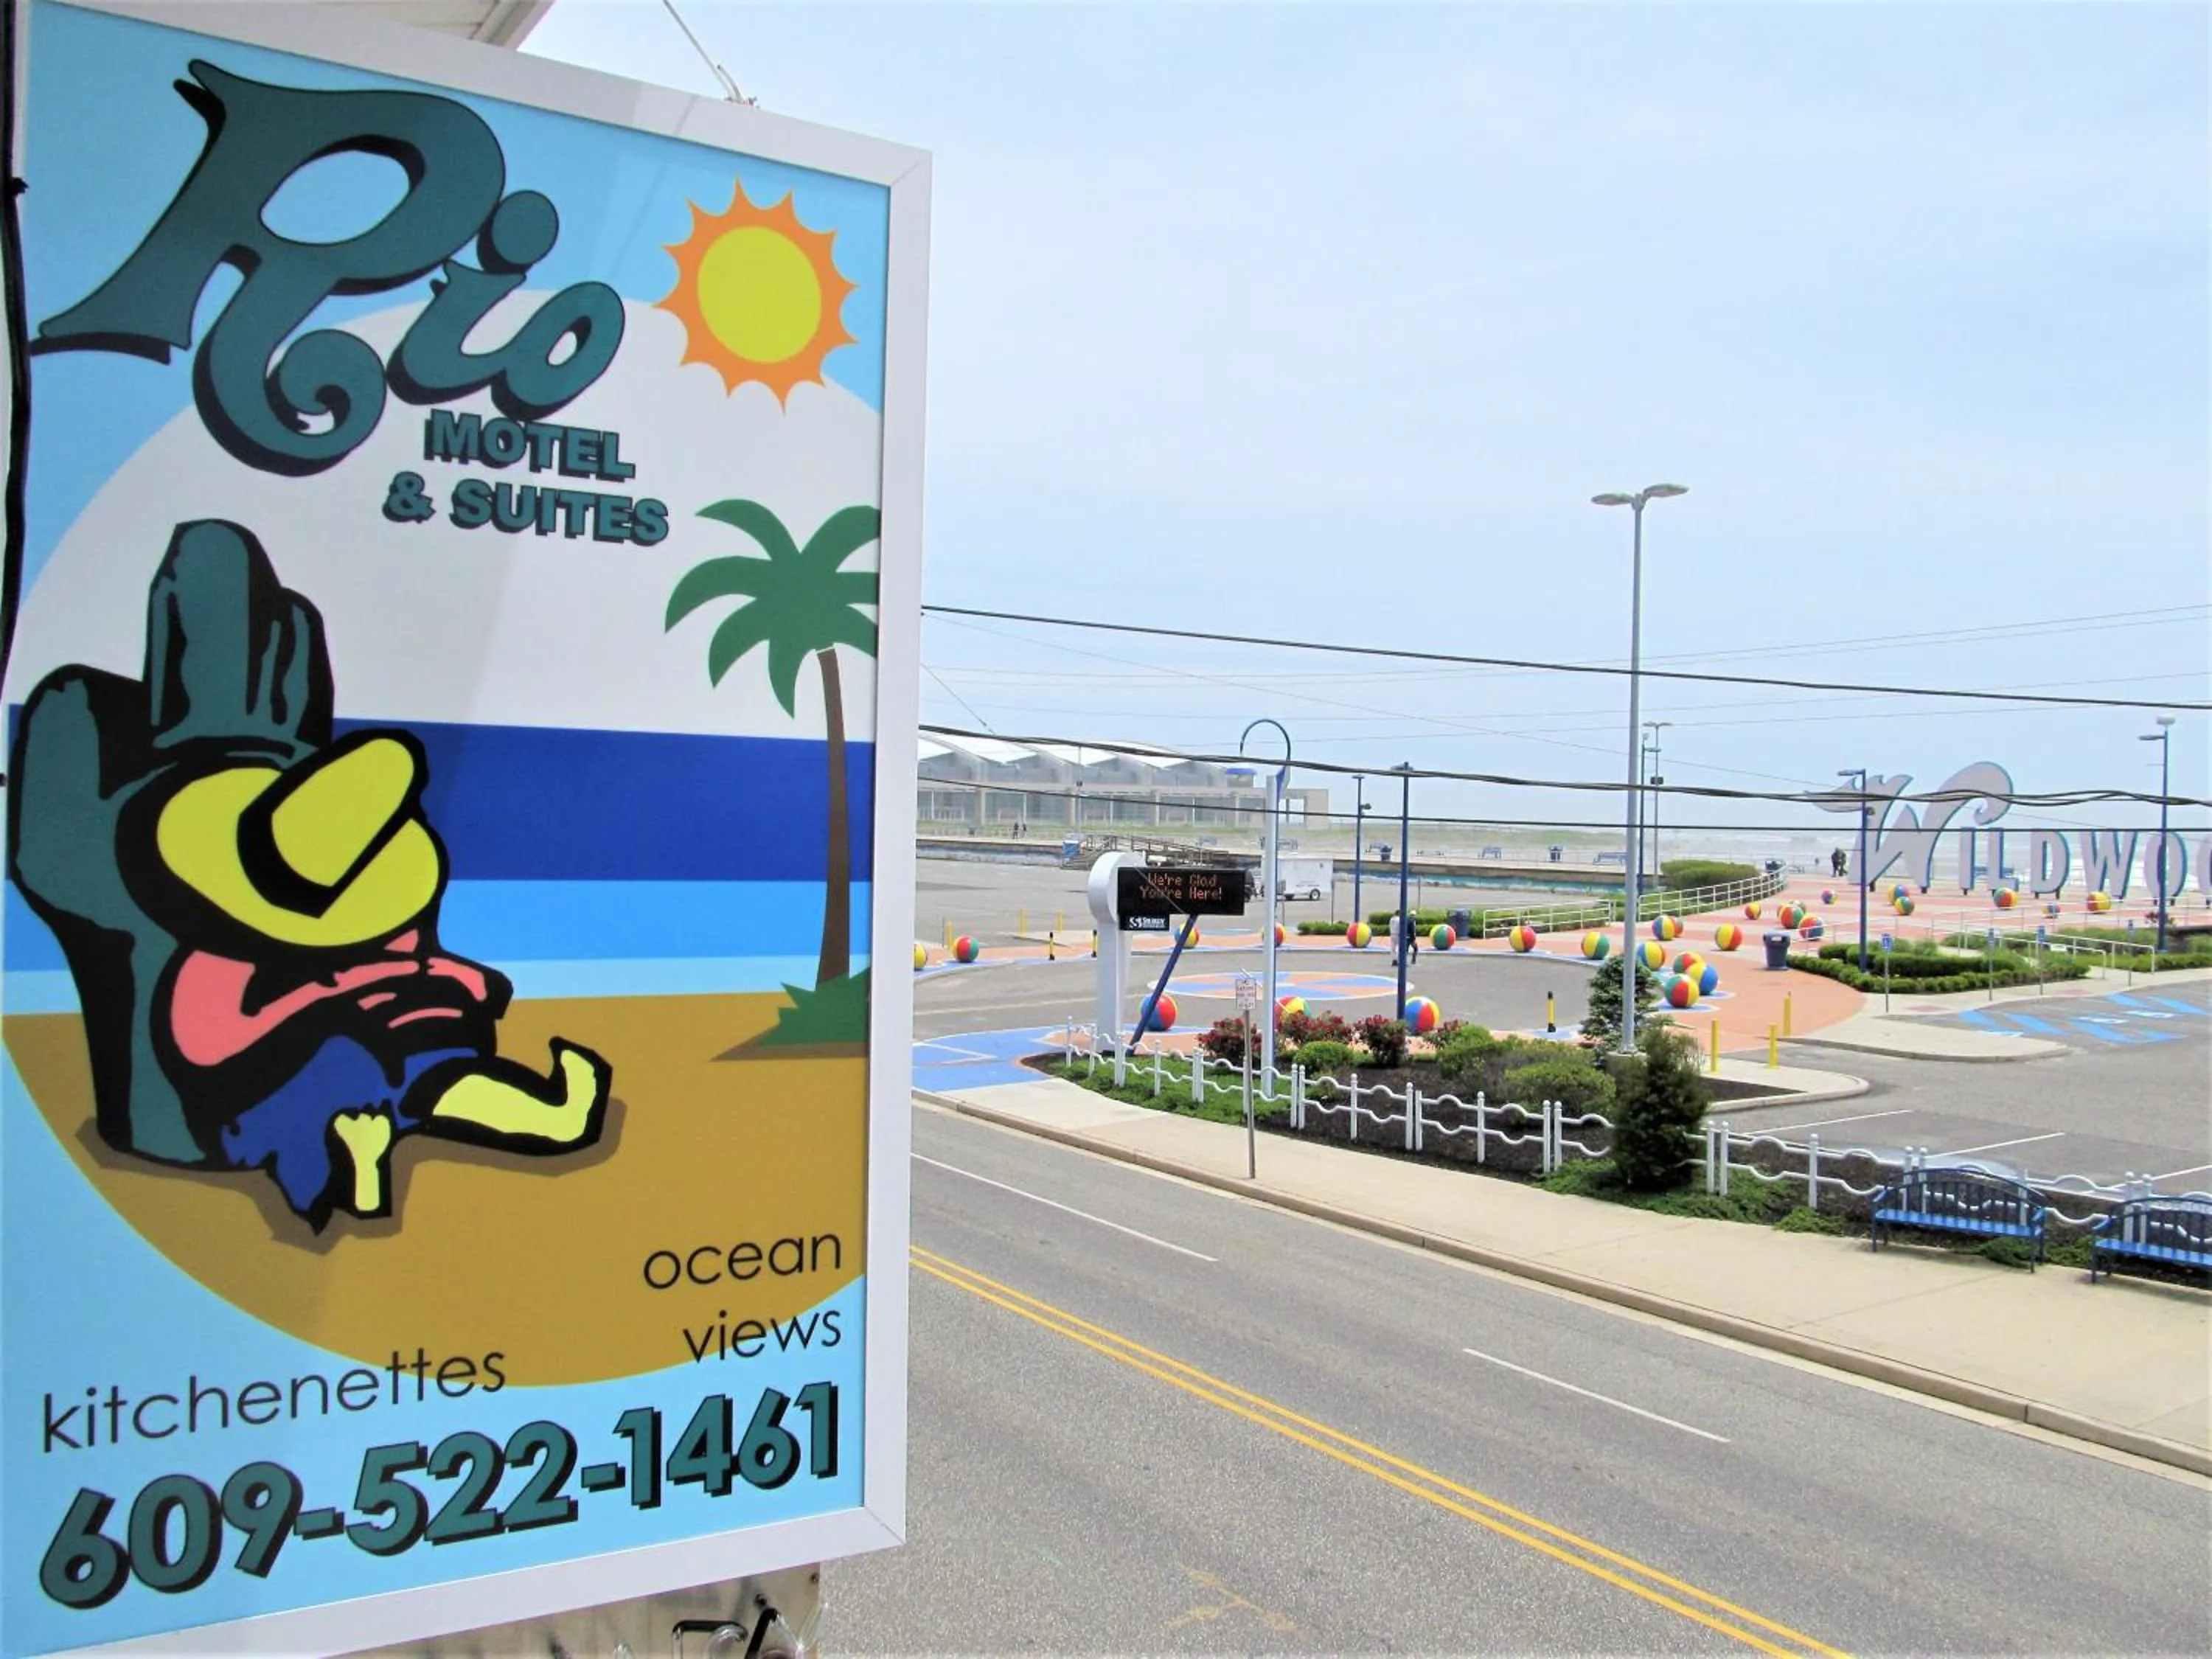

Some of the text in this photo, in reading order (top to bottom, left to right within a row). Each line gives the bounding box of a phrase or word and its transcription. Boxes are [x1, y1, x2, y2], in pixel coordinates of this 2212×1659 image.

[30, 58, 625, 477] Rio
[424, 408, 636, 481] MOTEL
[383, 471, 669, 546] & SUITES
[1139, 886, 1222, 900] You're Here!
[1147, 872, 1216, 886] We're Glad
[644, 1234, 841, 1289] ocean
[683, 1309, 842, 1363] views
[42, 1351, 506, 1453] kitchenettes
[39, 1381, 839, 1609] 609-522-1461
